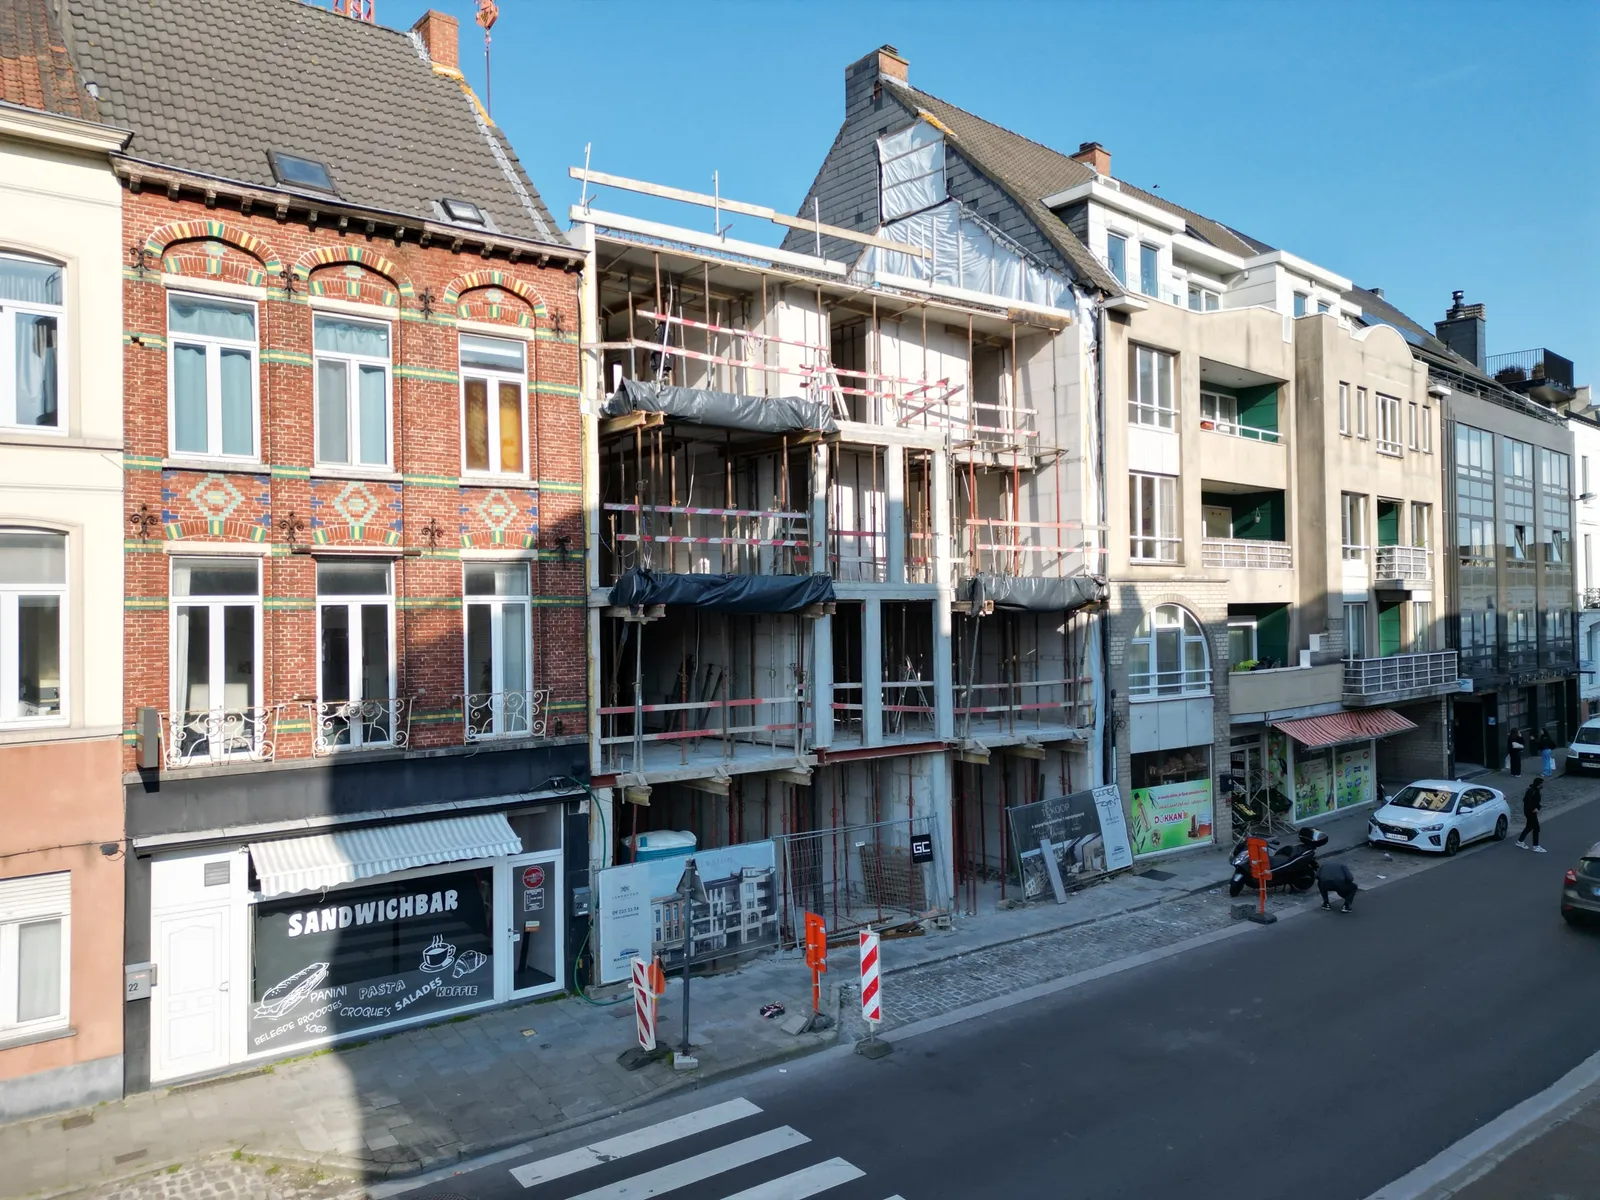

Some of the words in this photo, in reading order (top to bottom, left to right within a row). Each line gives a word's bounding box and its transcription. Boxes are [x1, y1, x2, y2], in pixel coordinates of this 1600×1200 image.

[912, 841, 931, 854] GC
[287, 889, 459, 938] SANDWICHBAR
[128, 982, 139, 992] 22
[310, 985, 347, 1003] PANINI
[358, 979, 407, 1001] PASTA
[394, 976, 443, 1012] SALADES
[435, 985, 479, 997] KOFFIE
[339, 1006, 392, 1018] CROQUE'S
[254, 1021, 296, 1046] BELEGDE
[297, 999, 343, 1027] BROODJES
[303, 1023, 328, 1034] SOEP
